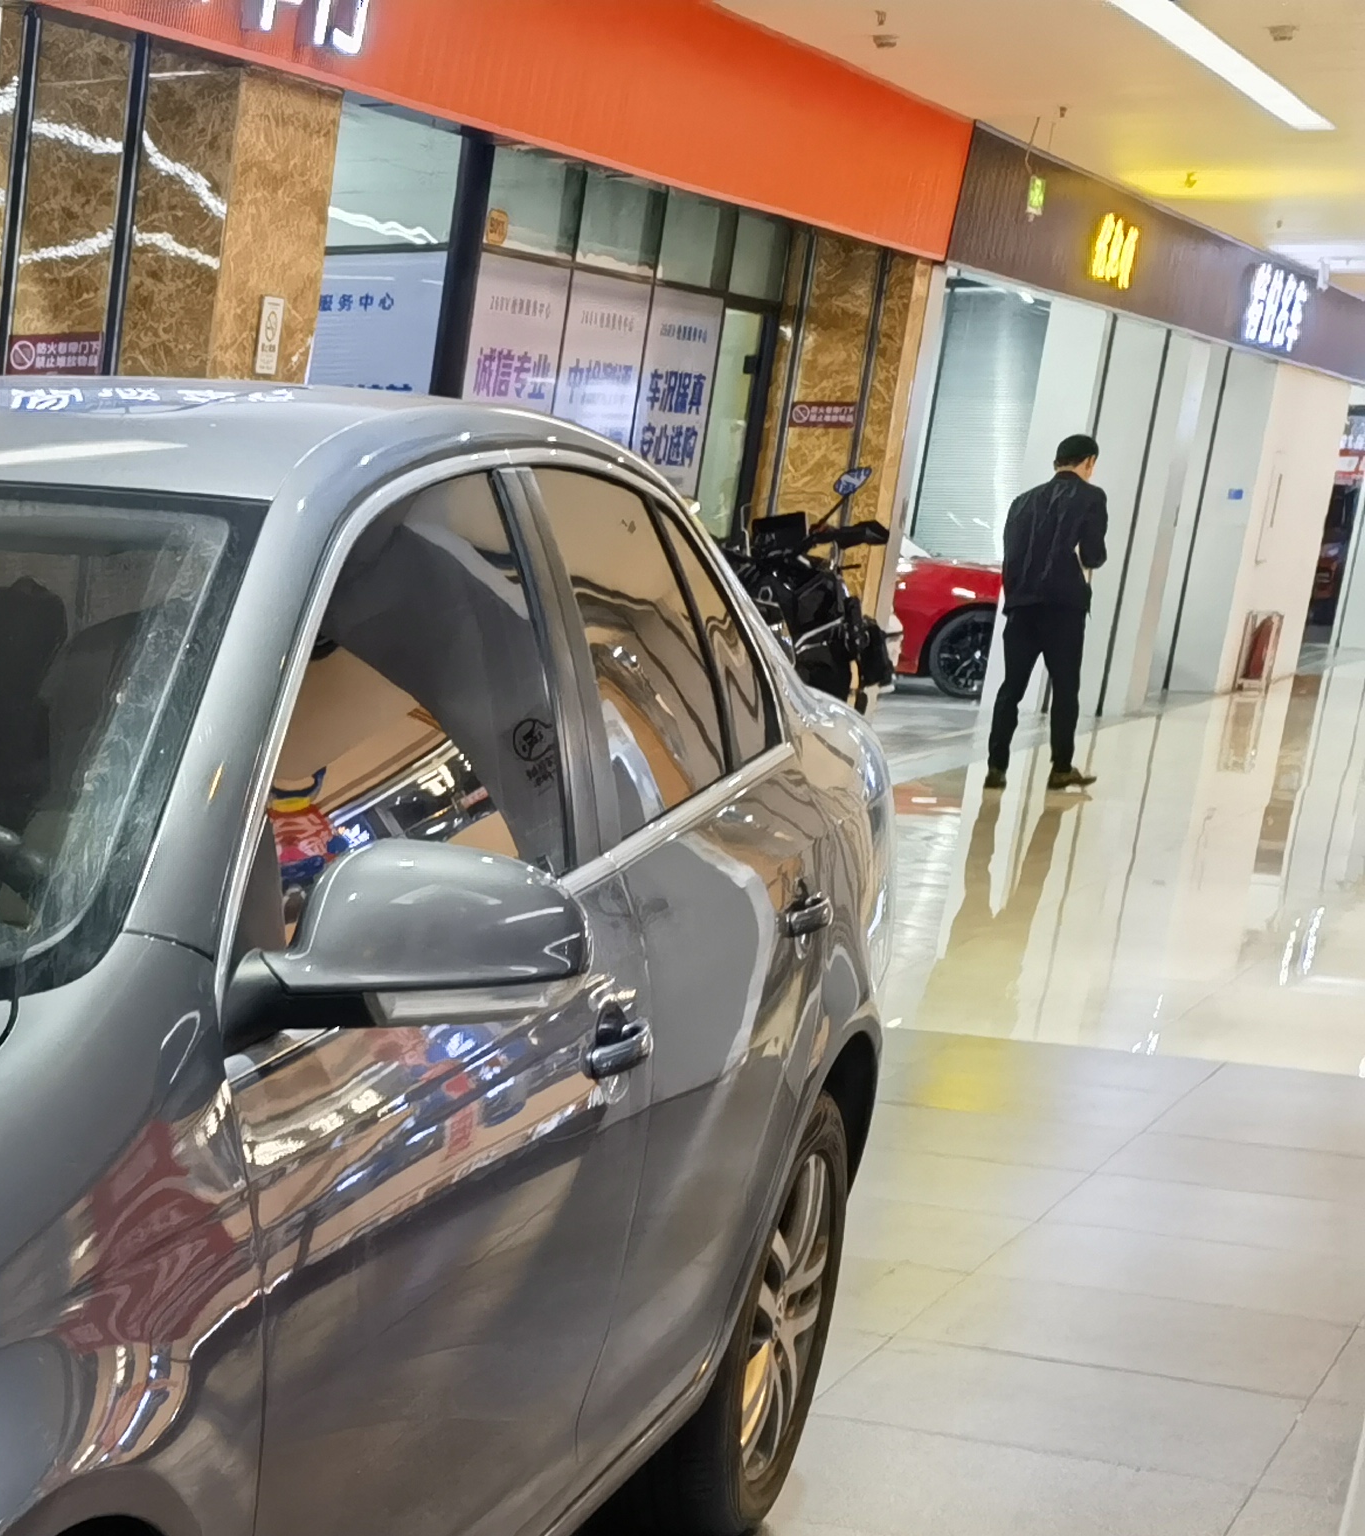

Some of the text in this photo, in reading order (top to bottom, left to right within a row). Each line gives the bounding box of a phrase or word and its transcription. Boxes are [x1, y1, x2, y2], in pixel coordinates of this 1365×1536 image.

[472, 347, 551, 400] 诚信专业
[646, 368, 707, 416] 车况保真
